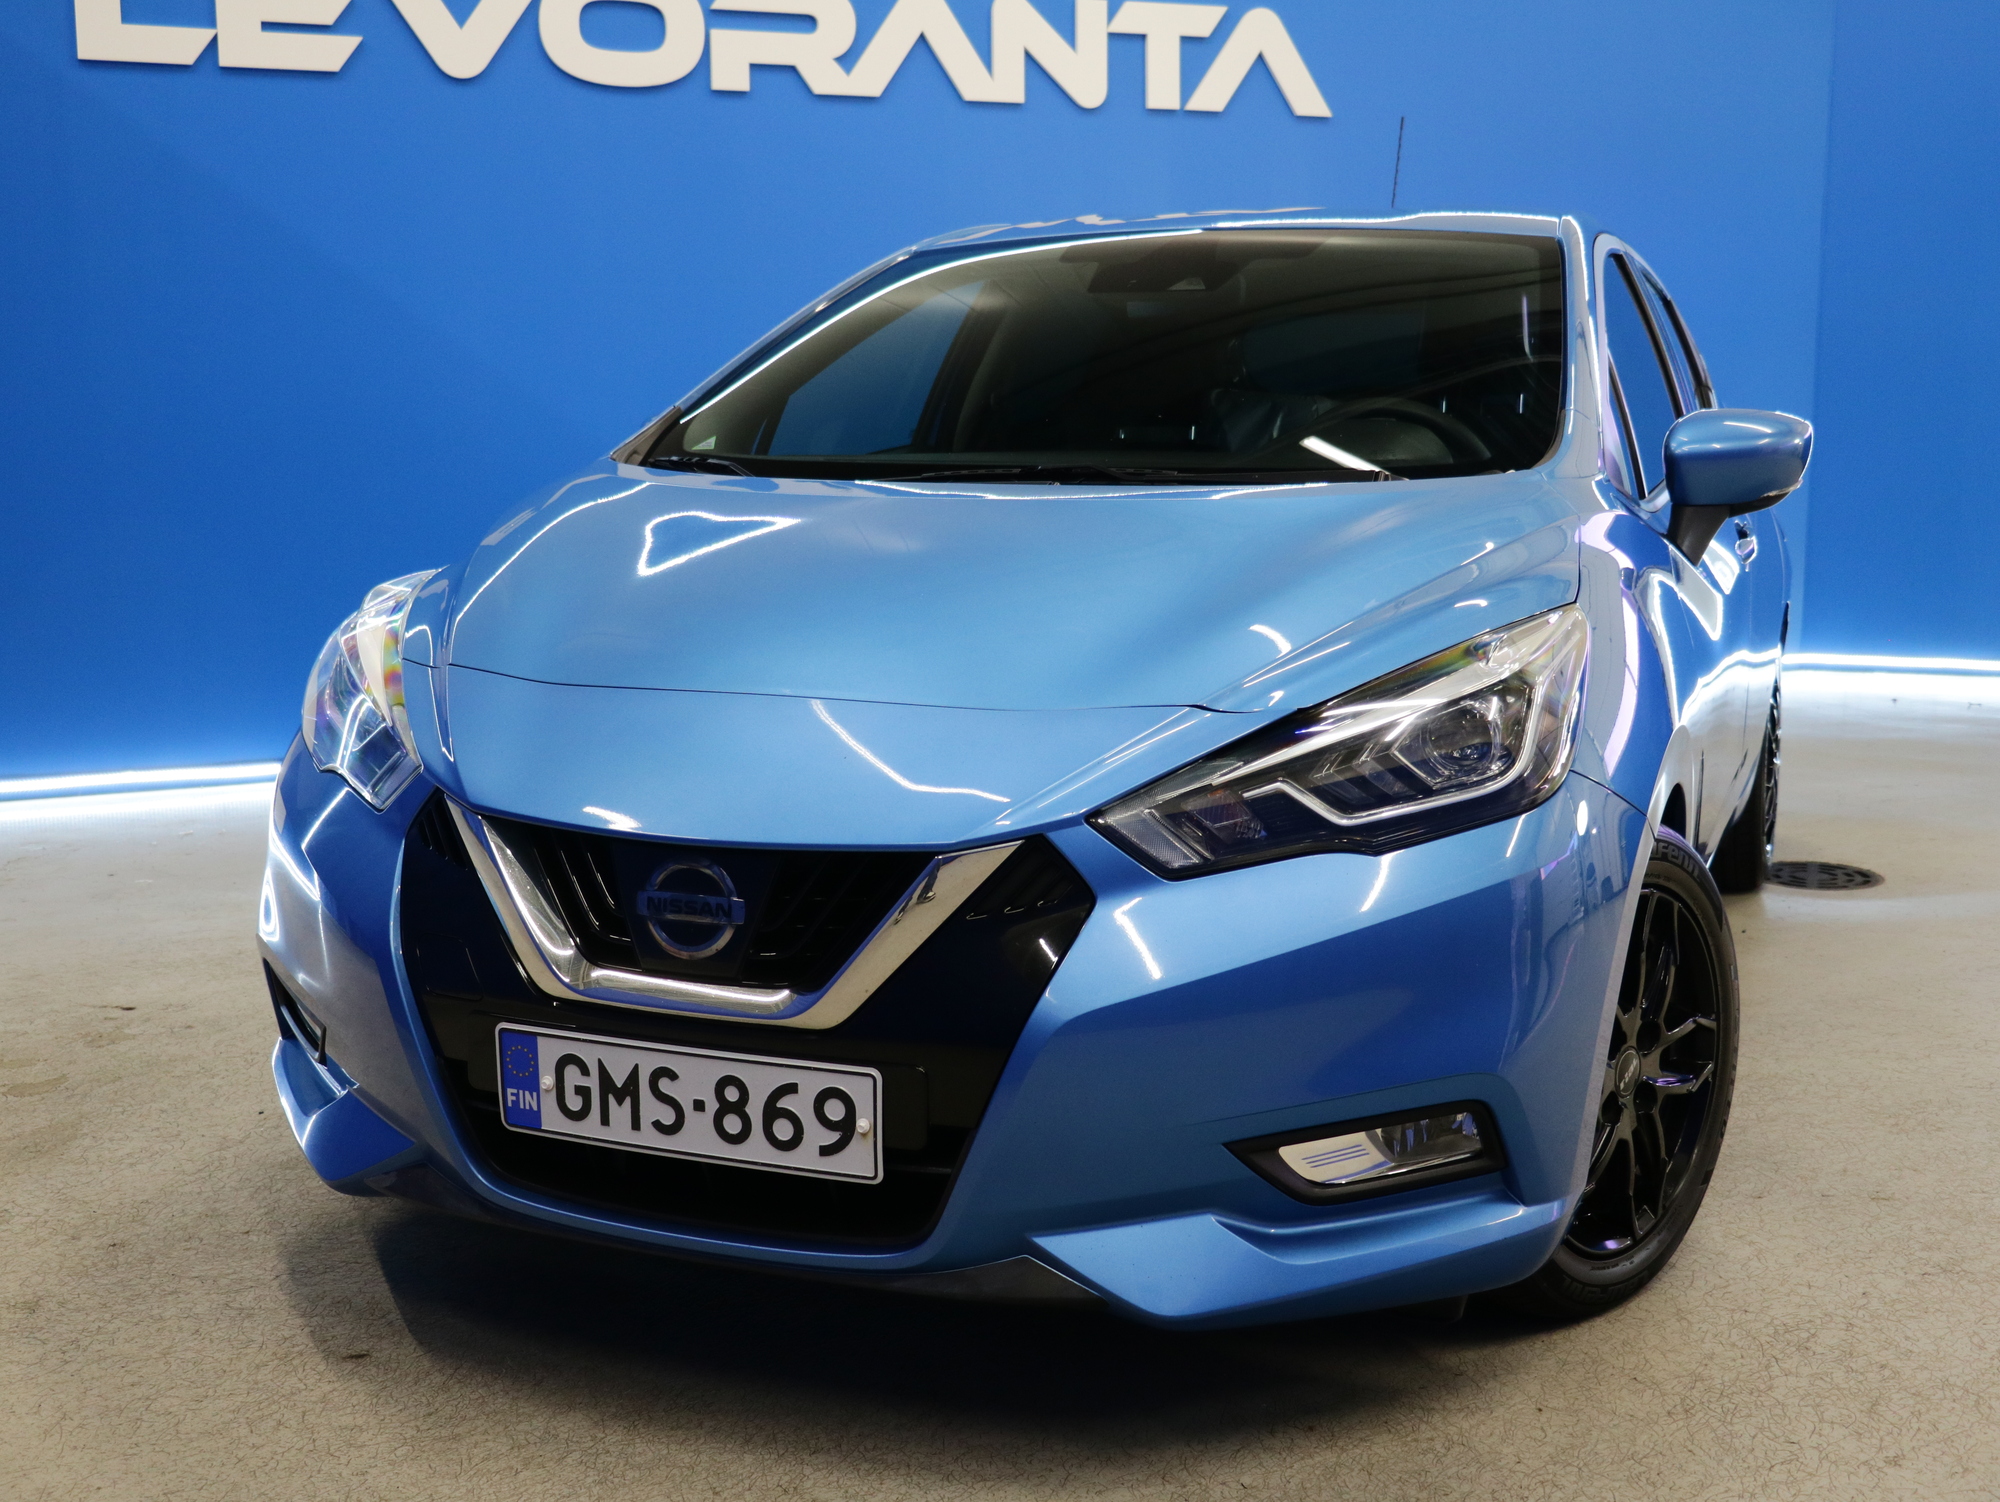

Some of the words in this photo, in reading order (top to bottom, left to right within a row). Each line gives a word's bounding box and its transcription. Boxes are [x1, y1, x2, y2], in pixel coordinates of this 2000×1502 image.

[646, 896, 733, 919] NISSAN
[507, 1088, 538, 1111] FIN
[554, 1052, 857, 1157] GMS-869
